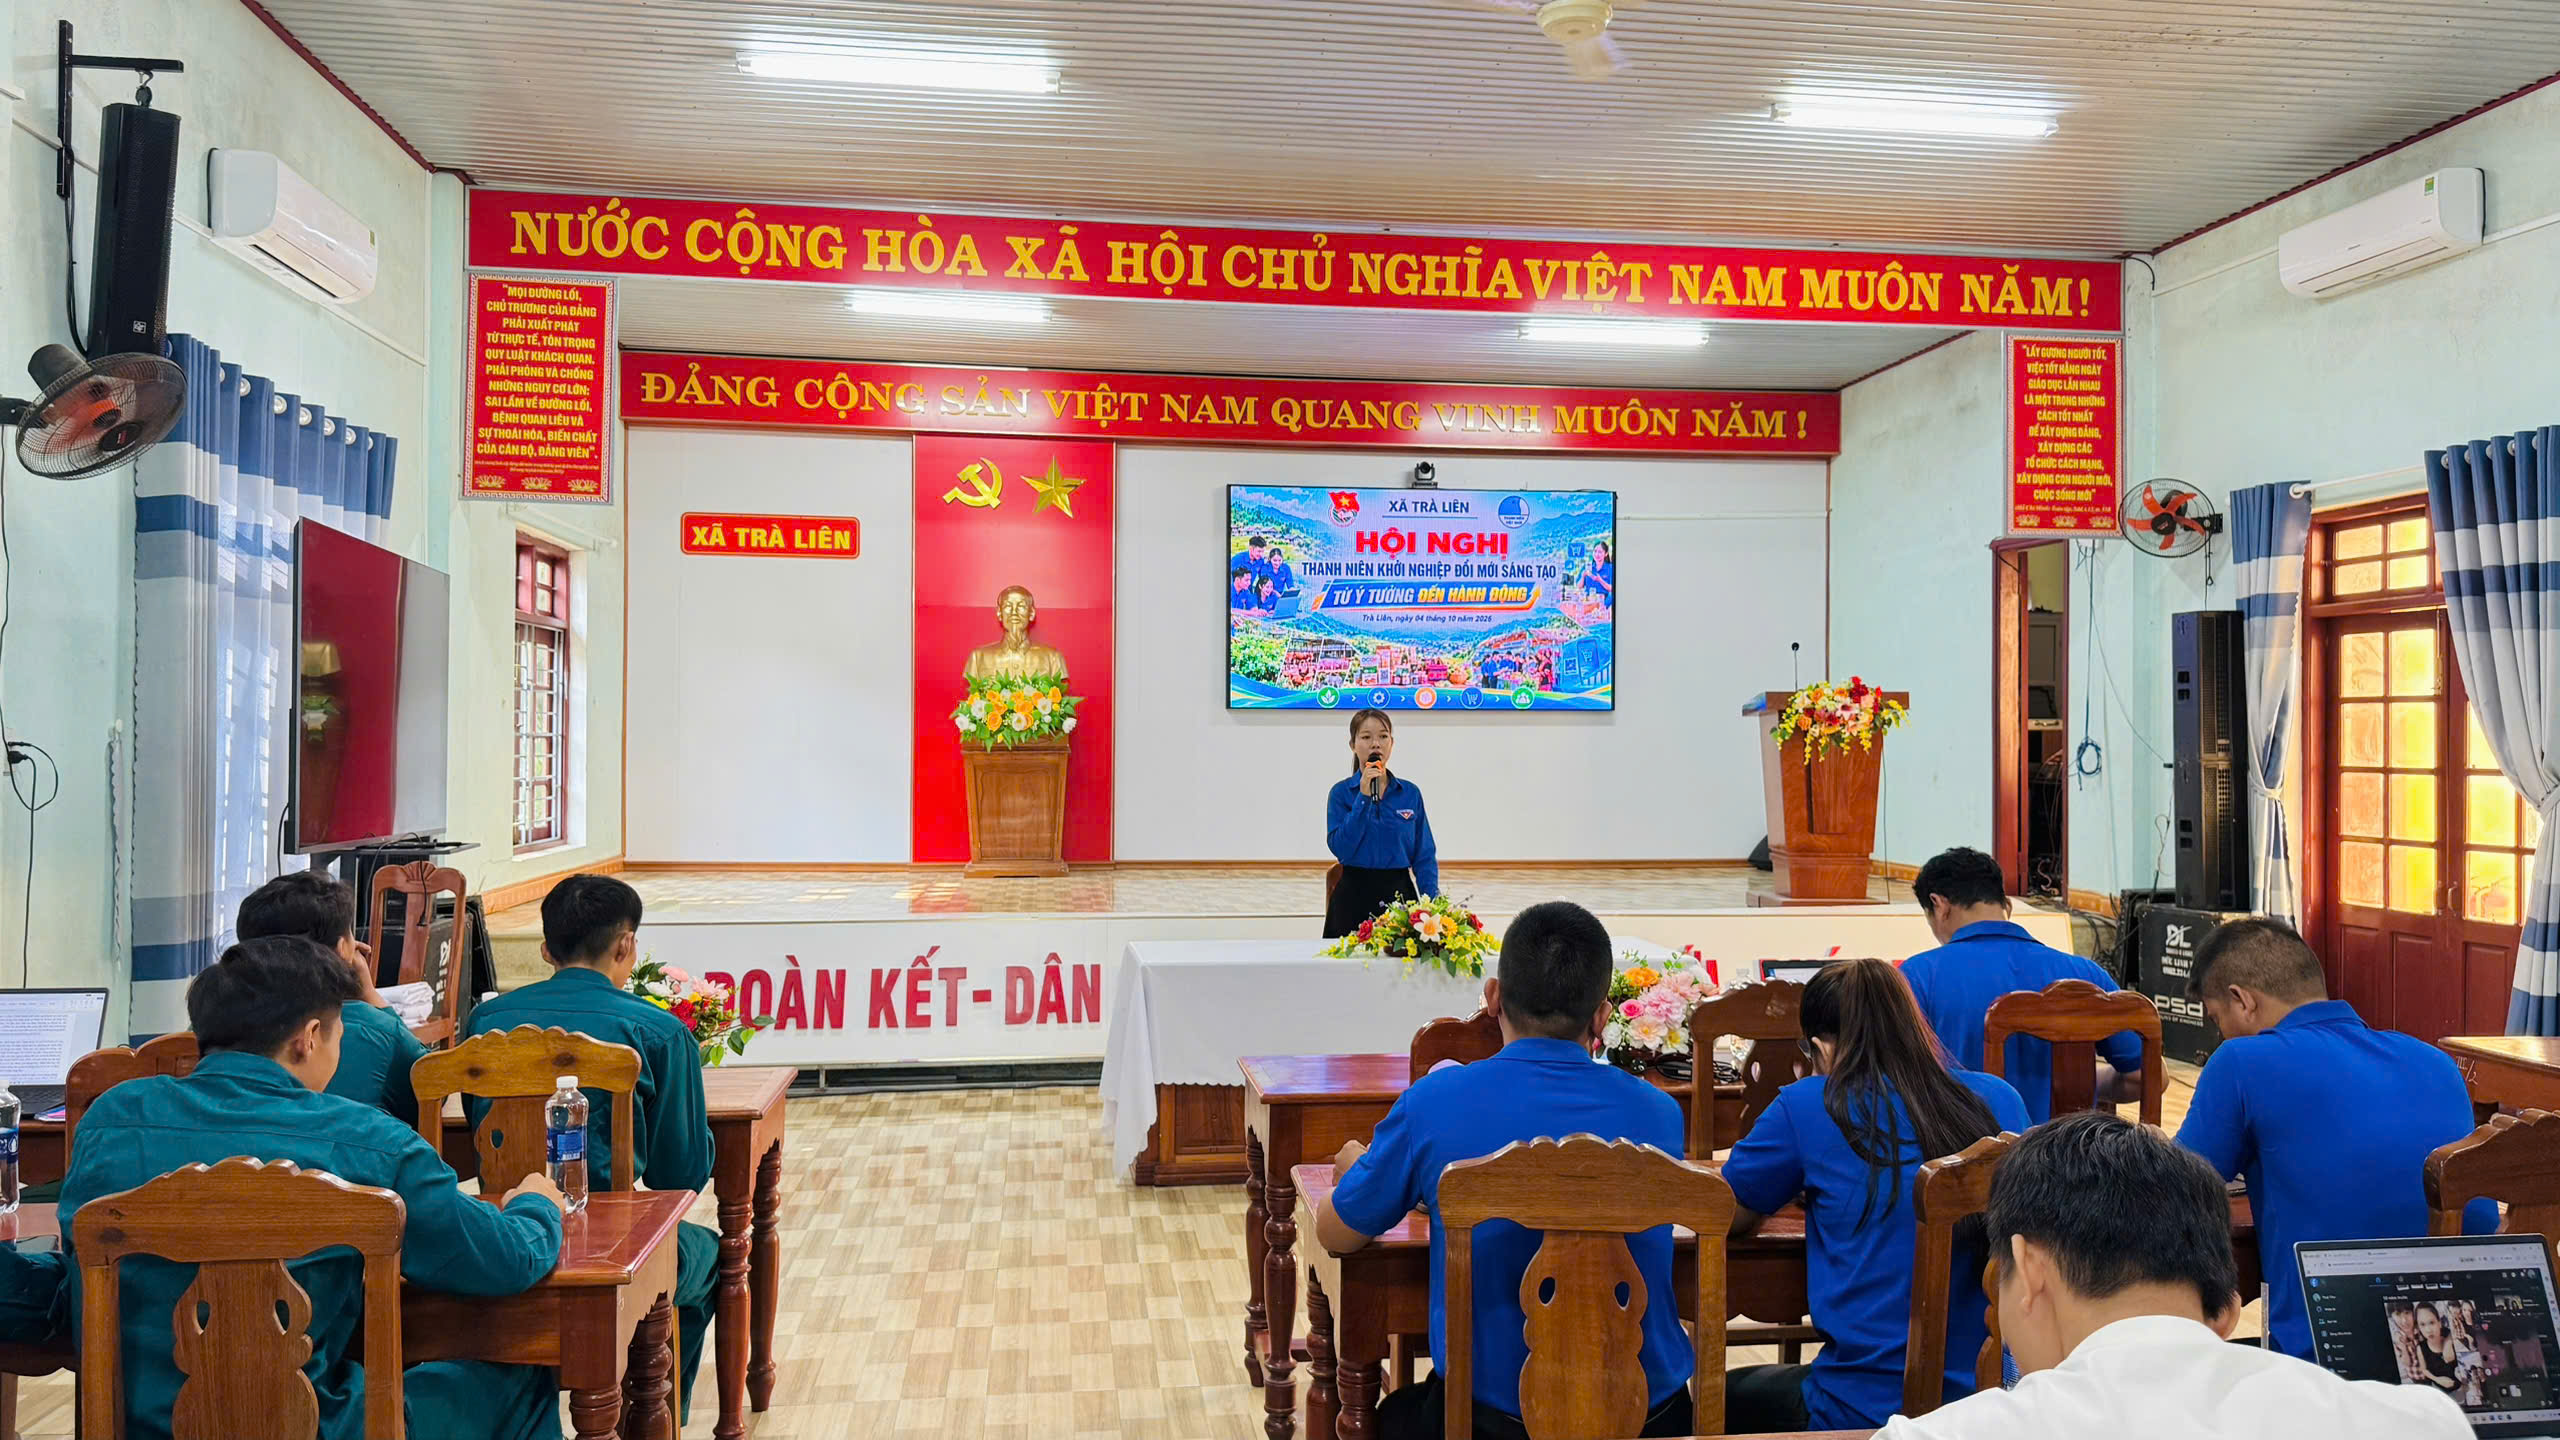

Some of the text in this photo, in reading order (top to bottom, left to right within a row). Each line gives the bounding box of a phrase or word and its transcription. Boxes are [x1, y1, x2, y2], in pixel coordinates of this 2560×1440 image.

[510, 197, 2090, 318] NƯỚC CỘNG HÒA XÃ HỘI CHỦ NGHĨA VIỆT NAM MUÔN NĂM!
[528, 286, 562, 300] ĐƯỜNG
[486, 298, 596, 317] CHỦ TRƯƠNG CỦA ĐẢNG
[502, 316, 580, 332] PHẢI XUẤT PHÁT
[563, 337, 596, 350] TRỌNG
[485, 348, 504, 360] QUY
[506, 348, 530, 362] LUẬT
[531, 350, 564, 362] KHÁCH
[486, 362, 594, 380] PHẢI PHÒNG VÀ CHỐNG
[2045, 360, 2058, 374] TỐT
[524, 382, 551, 394] NGUY
[552, 384, 567, 394] CƠ
[485, 396, 501, 407] SAI
[539, 396, 573, 410] ĐƯỜNG
[640, 362, 780, 408] ĐẢNG
[794, 372, 928, 419] CỘNG
[939, 375, 1030, 418] SẢN
[1043, 383, 1148, 428] VIỆT
[1160, 393, 1258, 426] NAM
[1270, 396, 1422, 432] QUANG
[1431, 402, 1542, 434] VINH
[1552, 398, 1680, 437] MUÔN
[1690, 400, 1787, 438] NĂM
[492, 411, 584, 426] BỆNH QUAN LIÊU VÀ
[2058, 408, 2071, 422] TỐT
[494, 428, 523, 440] THOÁI
[548, 429, 570, 442] BIẾN
[572, 429, 598, 443] CHẤT
[477, 440, 497, 454] CỦA
[498, 443, 519, 455] CÁN
[538, 443, 565, 457] ĐẢNG
[1389, 500, 1470, 514] XÃ TRÀ LIÊN
[692, 522, 850, 550] XÃ TRÀ LIÊN
[1356, 527, 1509, 560] HỘI NGHỊ
[1302, 560, 1556, 580] THANH NIÊN KHỞI NGHIỆP ĐỔI MỚI SÁNG TẠO
[1356, 587, 1365, 604] Ý
[1368, 588, 1414, 604] TƯỞNG
[1418, 586, 1443, 603] ĐẾN
[1447, 586, 1486, 602] HÀNH
[1488, 584, 1527, 603] ĐỘNG
[1362, 614, 1374, 622] Trà
[1426, 614, 1446, 624] tháng
[1005, 952, 1101, 1025] DÂN
